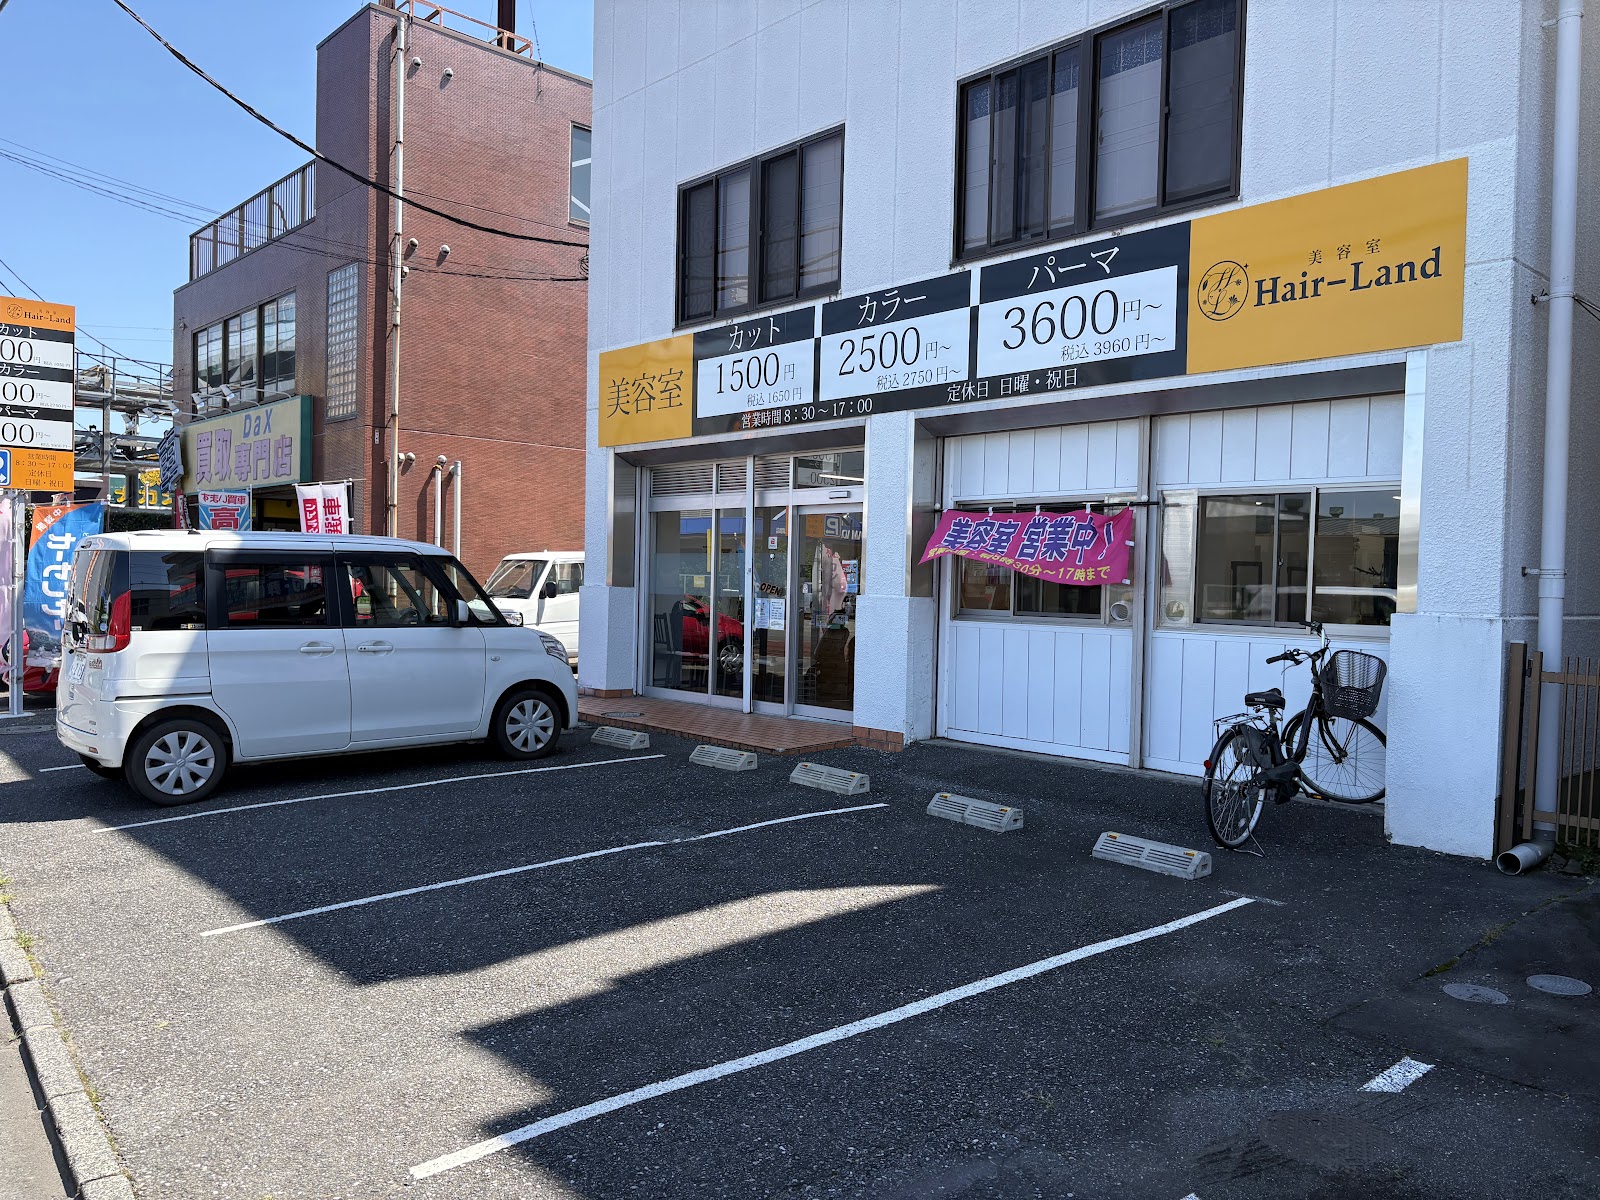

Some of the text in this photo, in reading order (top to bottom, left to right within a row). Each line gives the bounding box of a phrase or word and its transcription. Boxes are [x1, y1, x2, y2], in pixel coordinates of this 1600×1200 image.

[1027, 246, 1120, 289] パーマ
[1308, 238, 1381, 266] 美容室
[1254, 246, 1442, 307] Hair-Land
[24, 311, 71, 324] Hair-Land
[858, 290, 927, 326] カラー
[0, 323, 37, 339] カット
[729, 317, 781, 351] カット
[0, 363, 40, 376] カラー
[946, 368, 1078, 403] 定休日 日曜・祝日
[607, 368, 684, 418] 美容室
[242, 408, 273, 439] DaX
[28, 469, 52, 478] 定休日
[195, 428, 293, 485] 買取専門店
[943, 516, 1021, 556] 美容室
